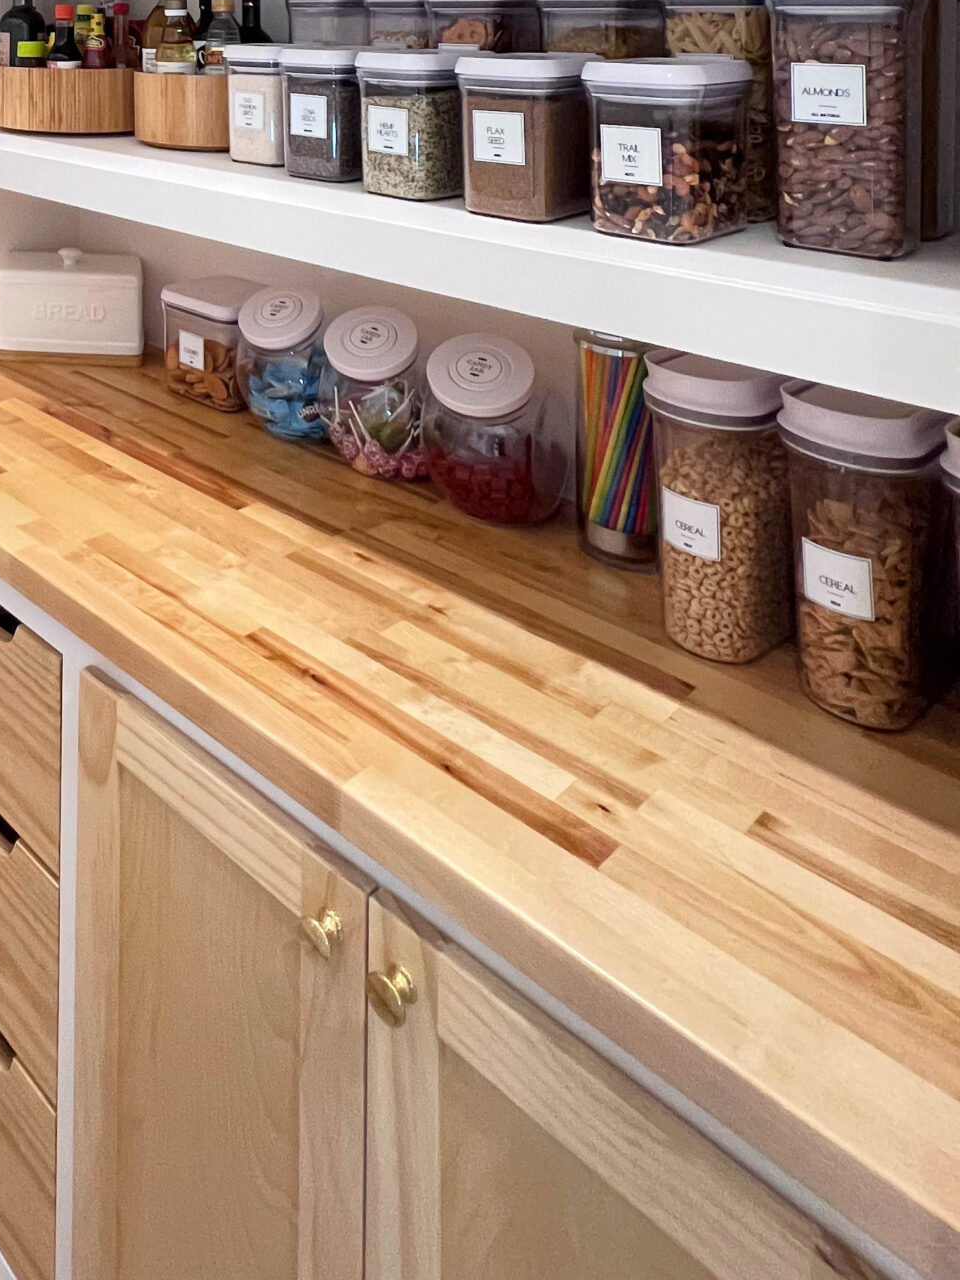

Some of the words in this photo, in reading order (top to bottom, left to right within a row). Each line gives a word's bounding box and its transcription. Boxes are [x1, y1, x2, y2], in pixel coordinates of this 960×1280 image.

[801, 86, 851, 98] ALMONDS
[379, 122, 394, 130] HEMP
[486, 126, 505, 135] FLAX
[376, 130, 398, 138] HEARTS
[487, 136, 505, 145] SEED
[617, 143, 640, 153] TRAIL
[622, 154, 637, 163] MIX
[33, 302, 108, 323] BREAD
[360, 327, 381, 339] CANDY
[466, 358, 493, 371] CANDY
[470, 366, 485, 375] JAR
[675, 520, 707, 538] CEREAL
[819, 575, 858, 595] CEREAL
